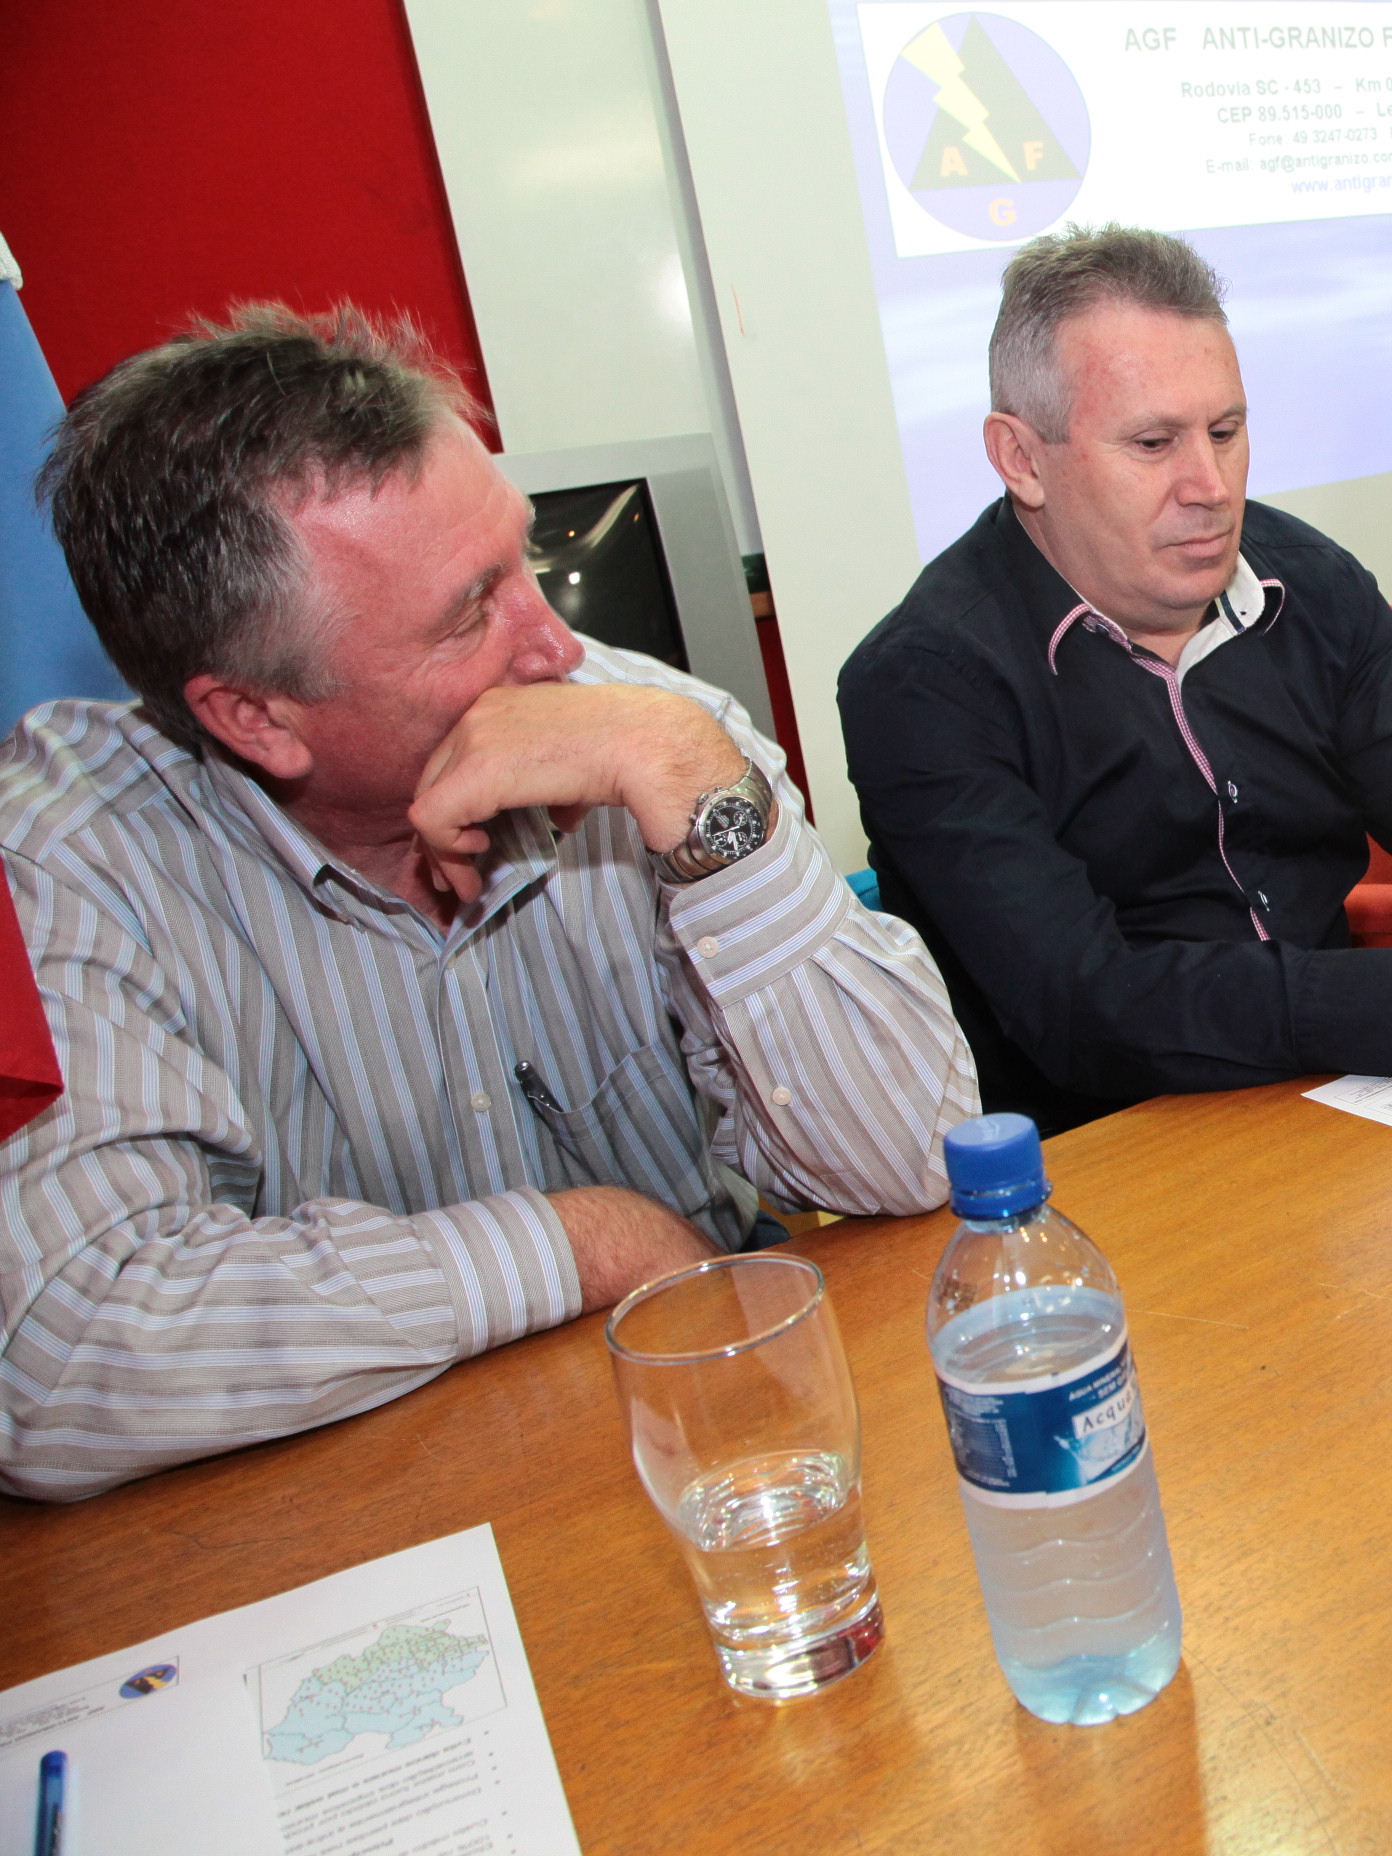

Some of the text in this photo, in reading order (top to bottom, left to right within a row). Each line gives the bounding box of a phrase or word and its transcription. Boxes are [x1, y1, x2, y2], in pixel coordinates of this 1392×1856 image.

[1125, 27, 1176, 51] AGF
[1203, 26, 1374, 49] ANTI-GRANIZO
[1181, 81, 1250, 97] Rodovia
[1256, 79, 1278, 95] SC
[1293, 79, 1320, 93] 453
[1355, 78, 1381, 91] Km
[1218, 106, 1252, 123] CEP
[1258, 104, 1342, 121] 89.515-000
[1249, 133, 1285, 145] Fone:
[1293, 131, 1307, 144] 49
[1313, 127, 1377, 143] 3247-0273
[941, 141, 1045, 176] A F
[1206, 158, 1253, 173] E-mail:
[989, 198, 1017, 226] G
